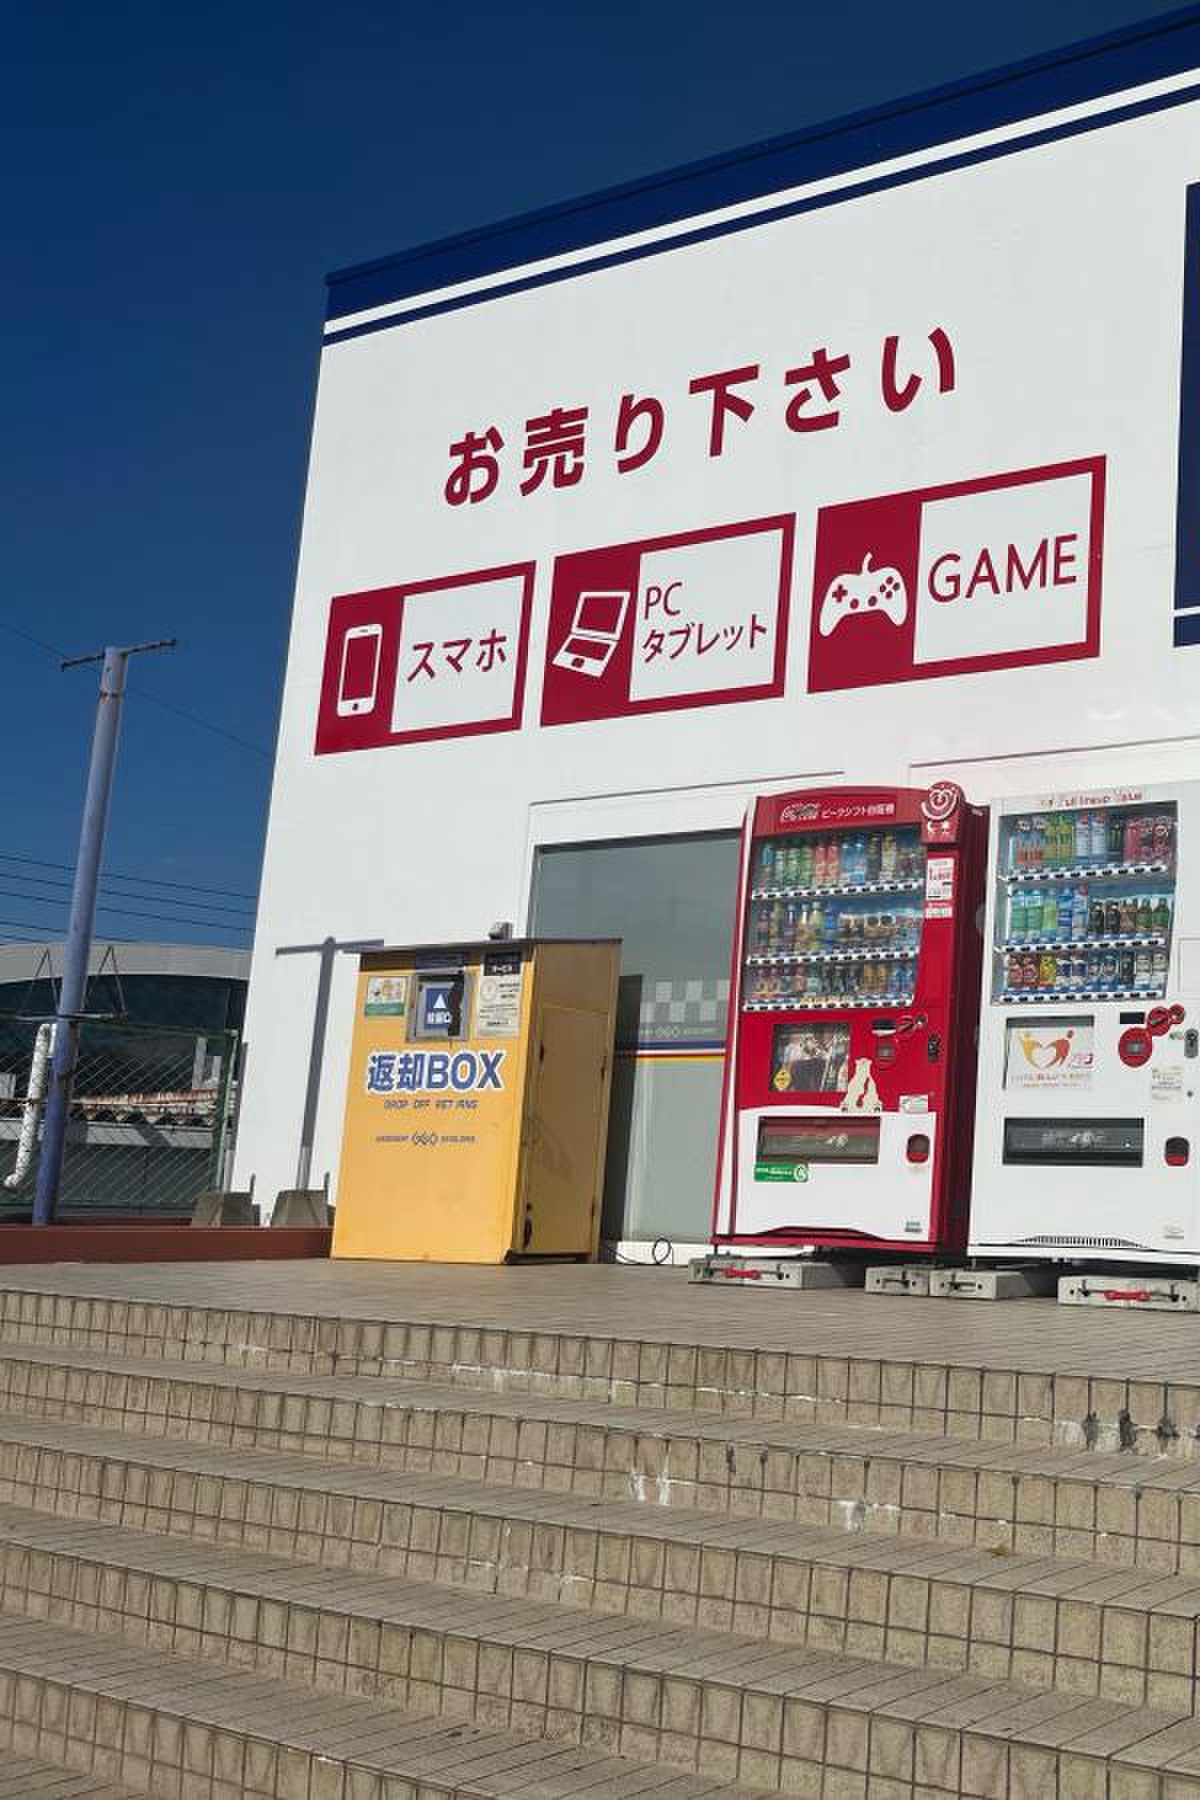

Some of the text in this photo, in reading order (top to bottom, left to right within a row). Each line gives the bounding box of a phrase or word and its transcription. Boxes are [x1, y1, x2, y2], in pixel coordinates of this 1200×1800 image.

[444, 326, 957, 508] お売り下さい
[926, 533, 1079, 604] GAME
[642, 581, 683, 621] PC
[407, 627, 509, 682] スマホ
[642, 612, 769, 664] タブレット
[367, 1052, 503, 1092] 返却BOX
